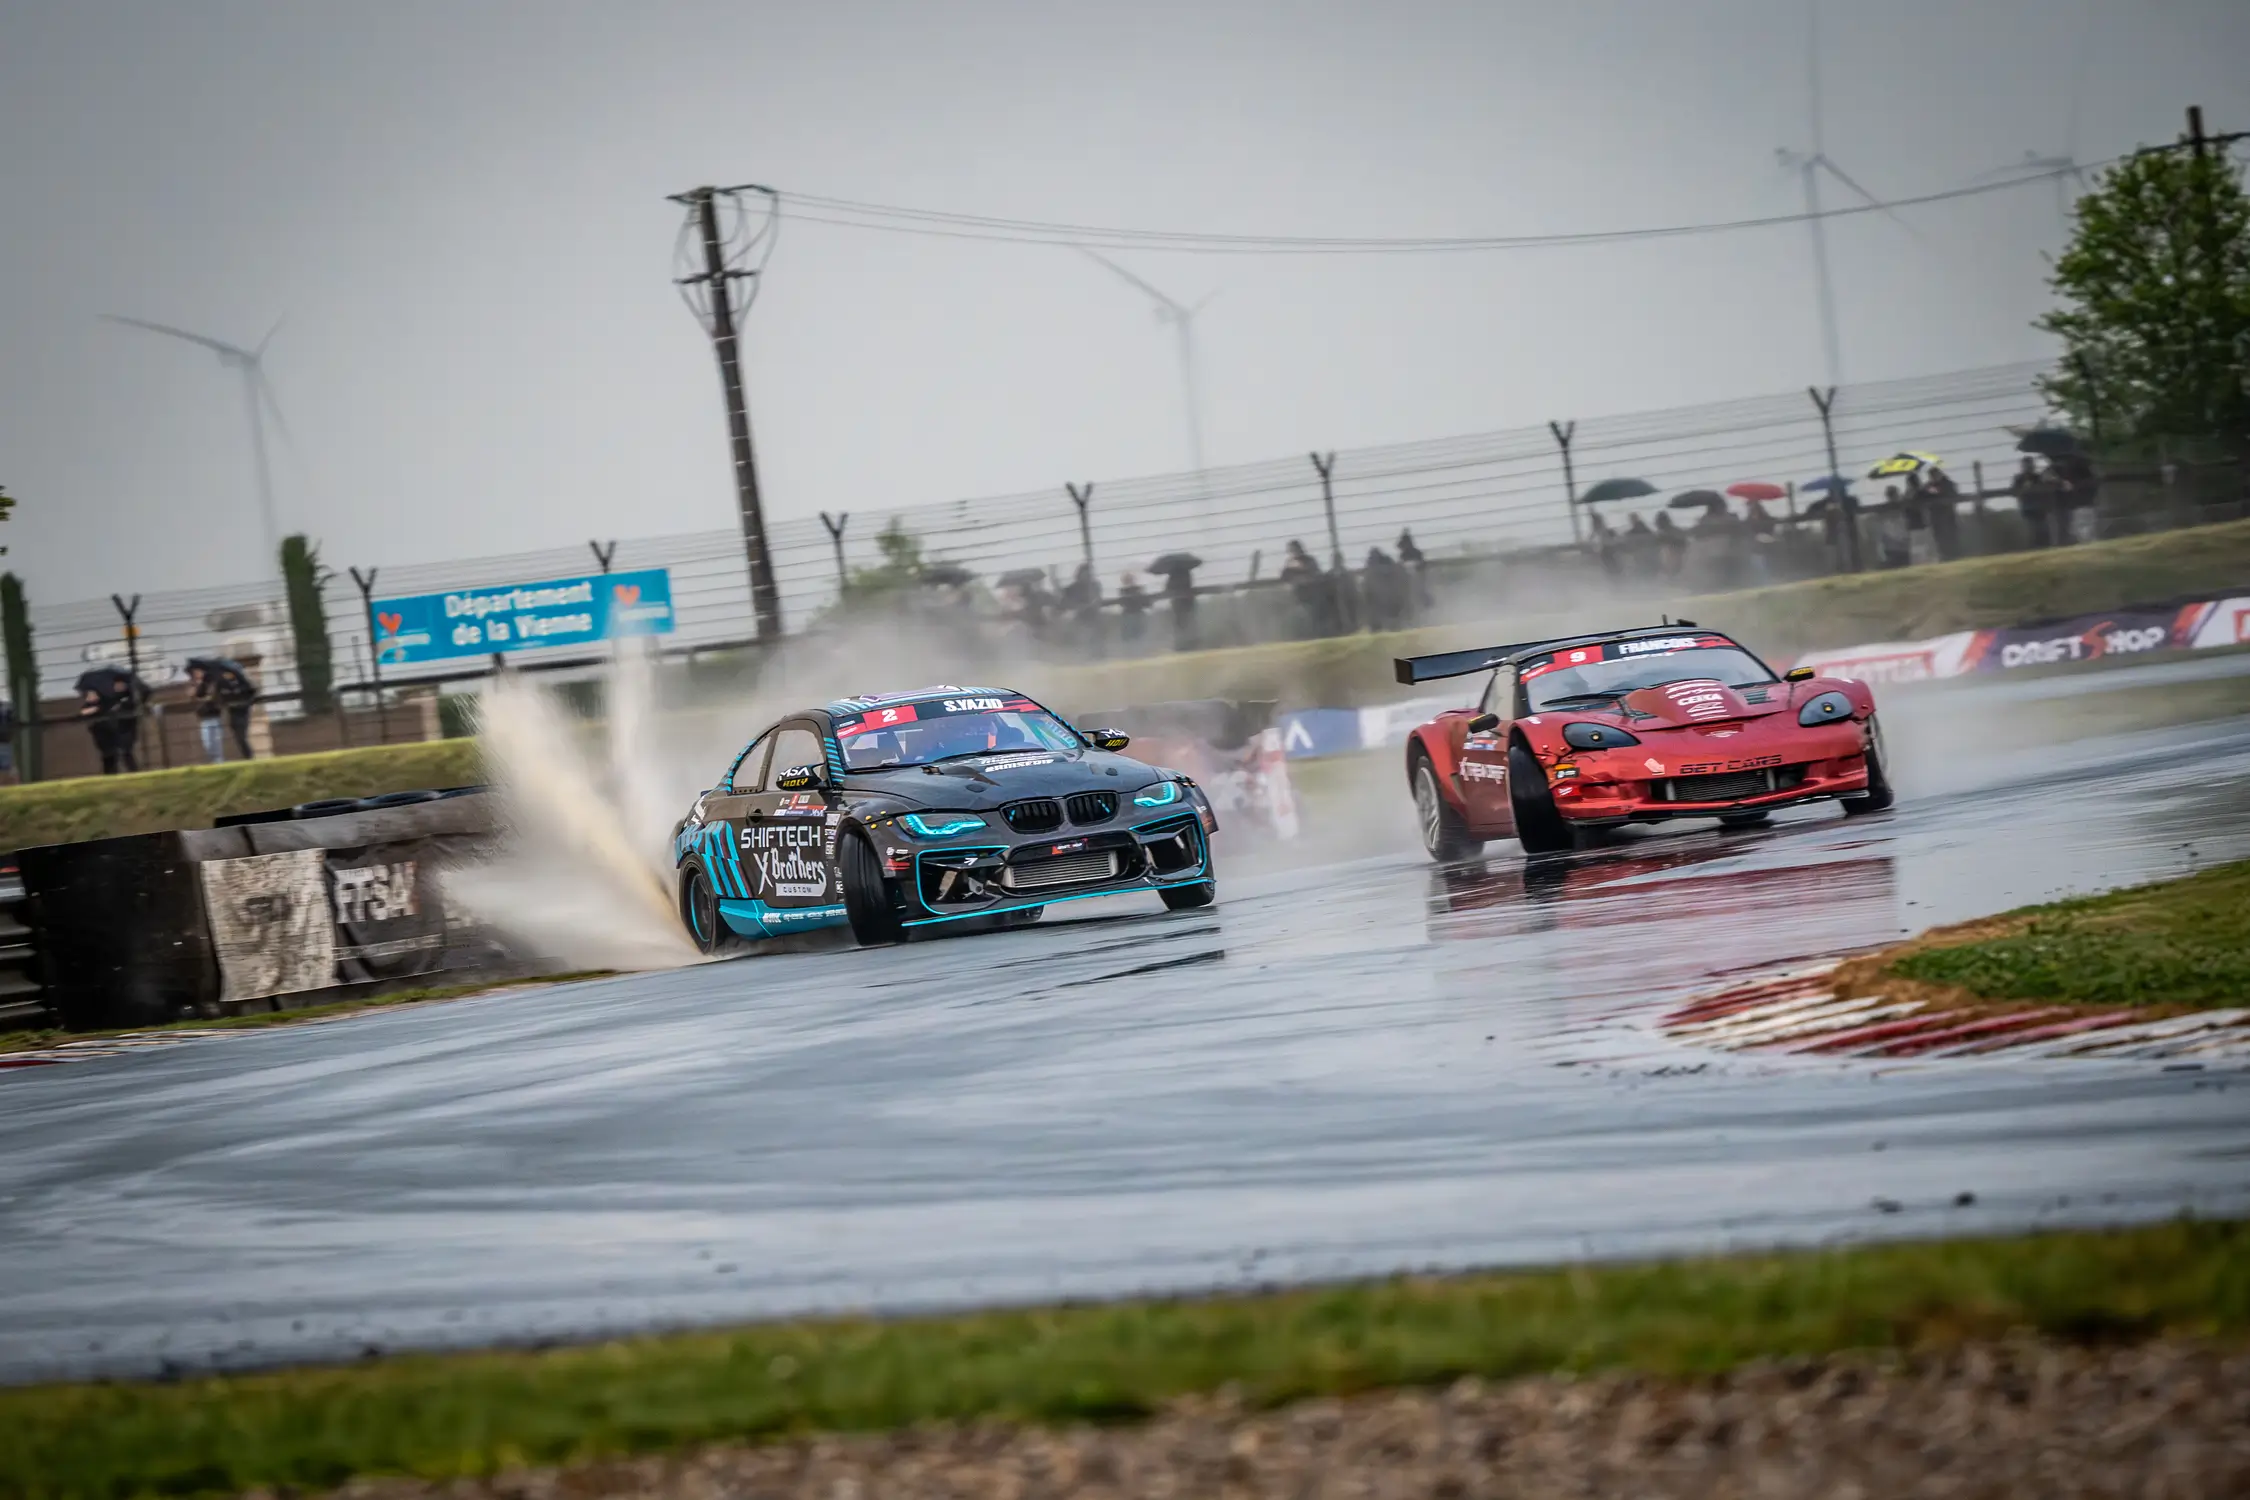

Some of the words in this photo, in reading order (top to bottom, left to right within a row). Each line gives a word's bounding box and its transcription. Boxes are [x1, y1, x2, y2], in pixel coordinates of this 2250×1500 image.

[444, 581, 593, 619] Département
[452, 622, 482, 646] de
[486, 619, 510, 642] la
[514, 613, 593, 638] Vienne
[1570, 652, 1587, 662] 9
[943, 698, 1004, 713] S.YAZID
[881, 709, 899, 723] 2
[1727, 754, 1782, 771] CARS
[740, 826, 821, 849] SHIFTECH
[770, 846, 827, 885] Brothers
[782, 886, 813, 894] CUSTOM
